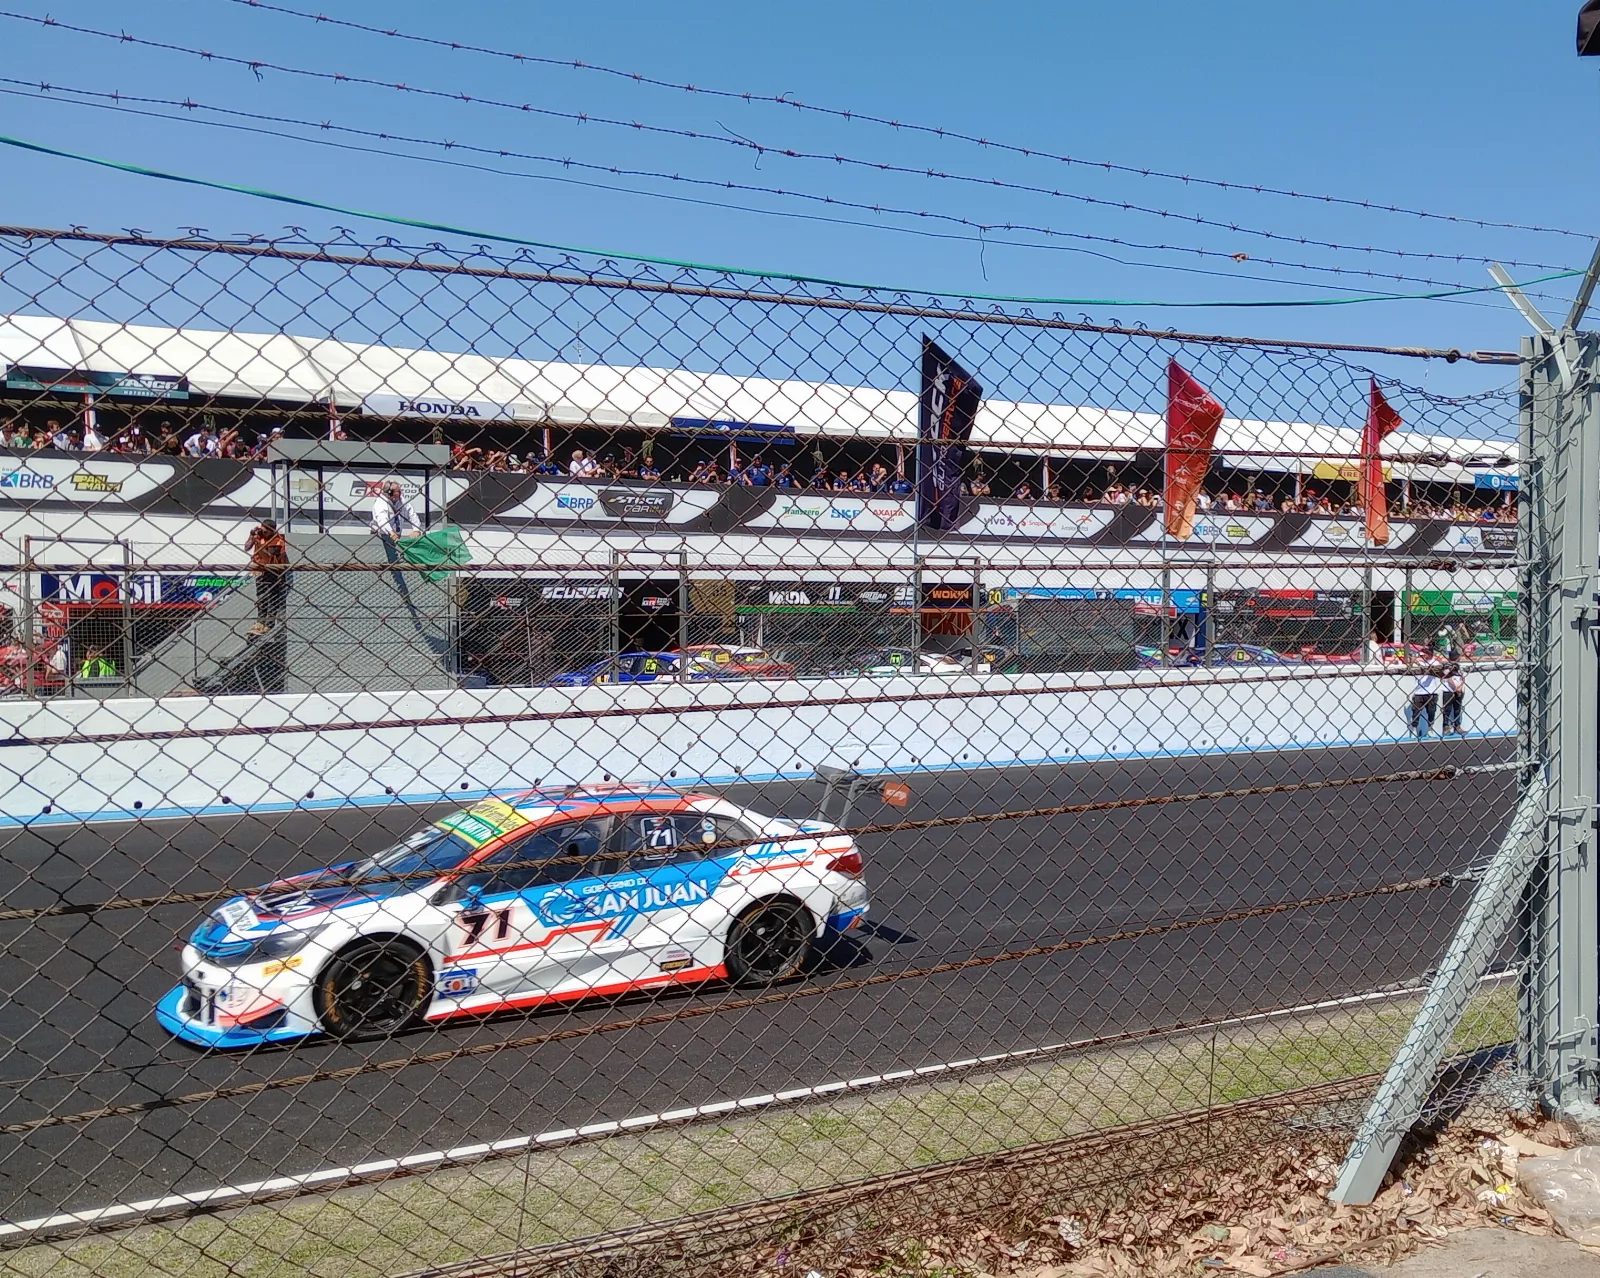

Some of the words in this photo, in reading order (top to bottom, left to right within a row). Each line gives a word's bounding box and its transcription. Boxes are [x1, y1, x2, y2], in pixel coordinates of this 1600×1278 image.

[115, 377, 179, 390] TANGO
[398, 401, 481, 416] HONDA
[20, 474, 54, 489] BRB
[569, 498, 594, 509] BRB
[615, 496, 665, 505] STOCK
[831, 509, 861, 518] SKF
[873, 509, 904, 517] AXALTA
[984, 516, 1005, 526] vivo
[59, 575, 162, 604] Mobil
[932, 590, 970, 599] WOKIN
[647, 829, 672, 846] 71
[583, 890, 638, 917] SAN
[643, 879, 709, 908] JUAN
[458, 908, 512, 947] 71
